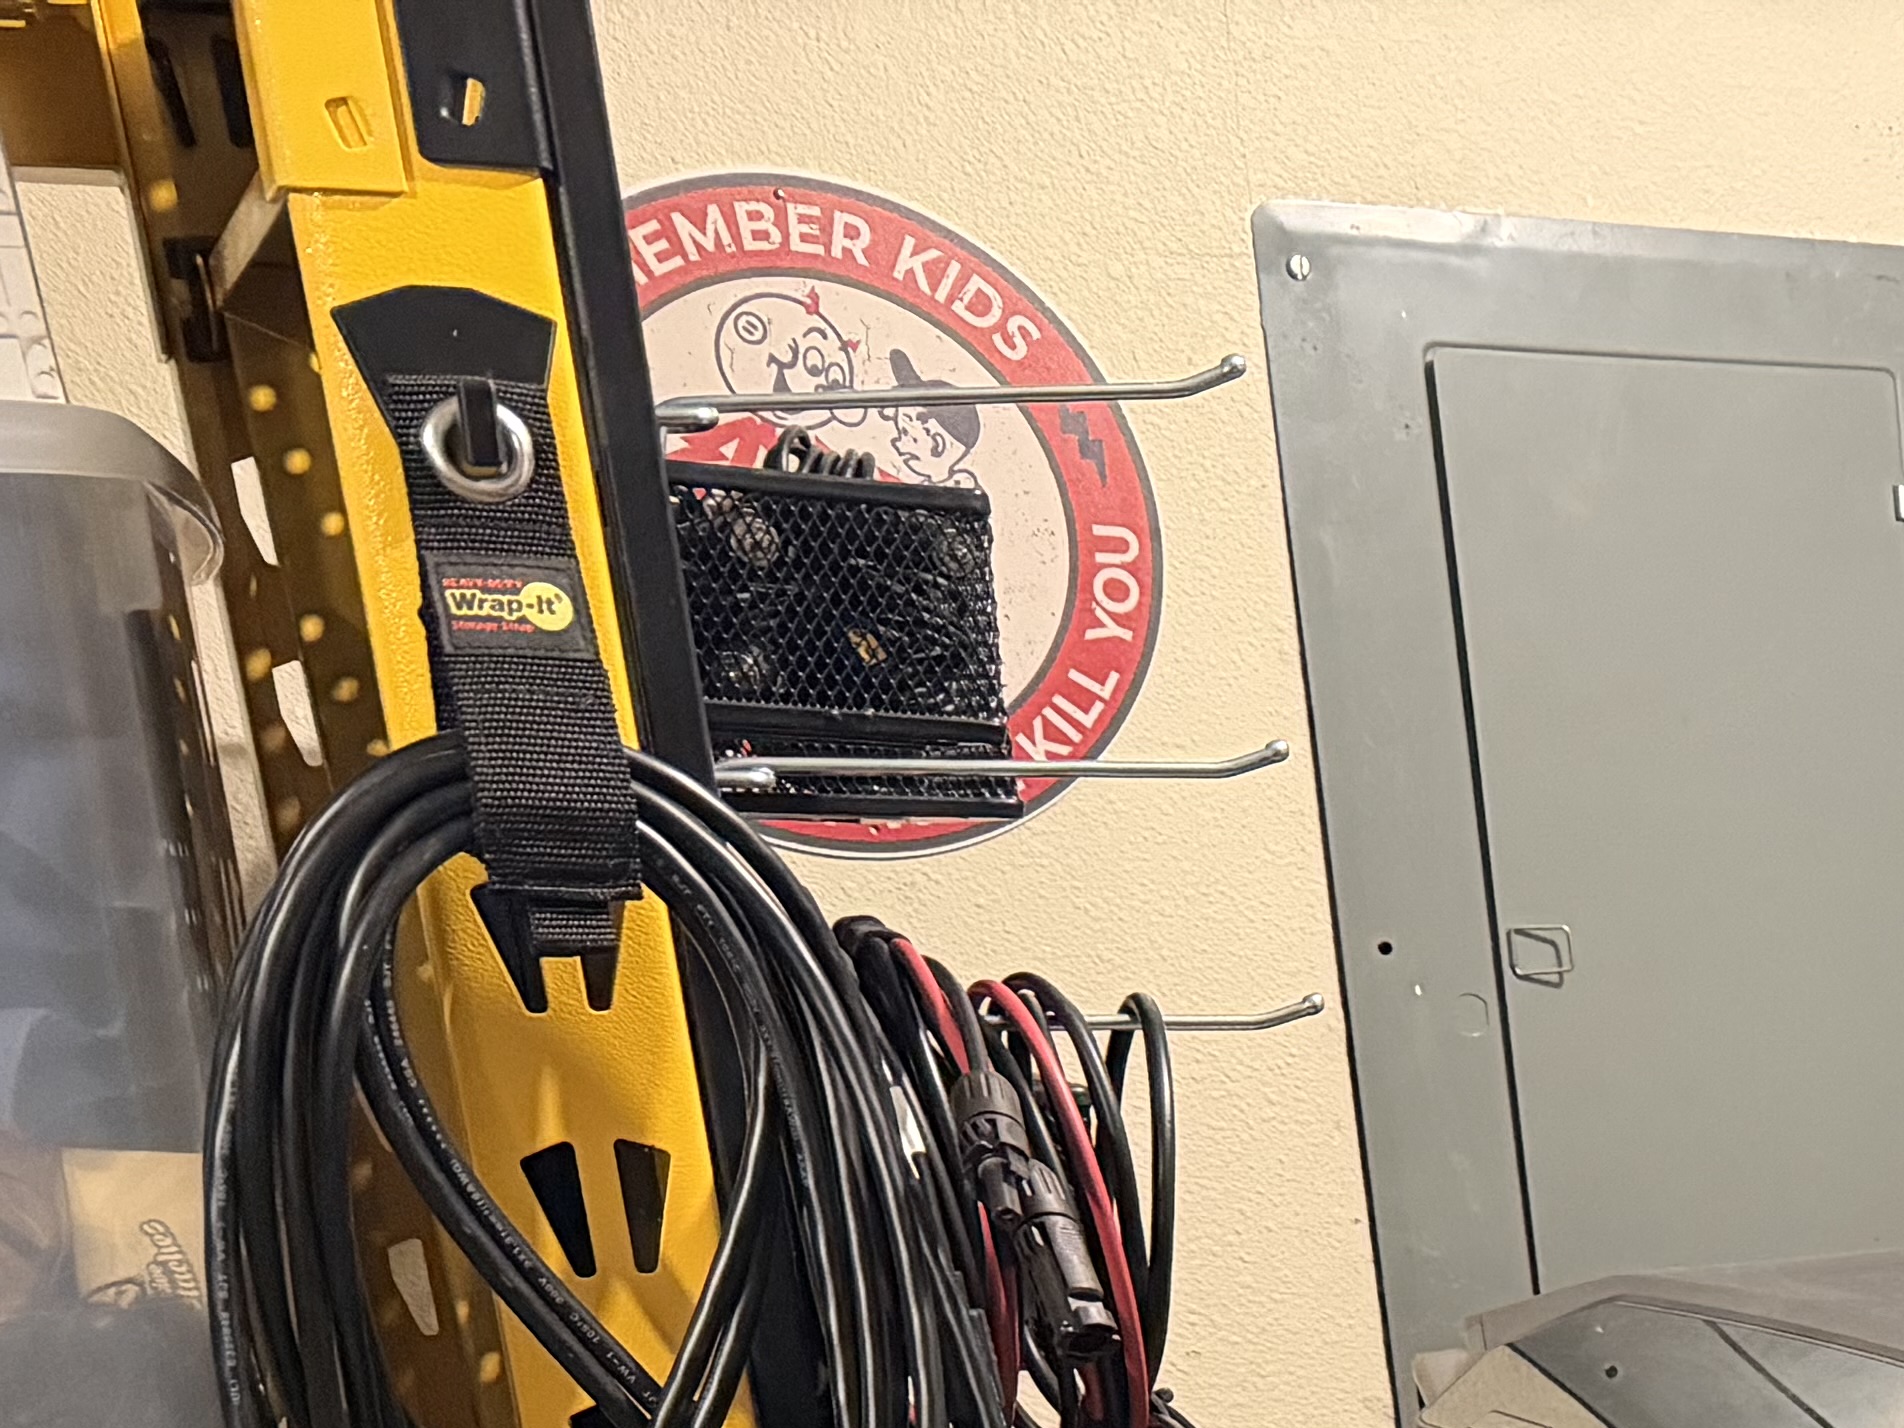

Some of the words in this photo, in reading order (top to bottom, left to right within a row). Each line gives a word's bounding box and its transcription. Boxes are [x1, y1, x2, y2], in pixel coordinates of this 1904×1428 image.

[892, 234, 1042, 362] KIDS
[1015, 668, 1120, 763] KILL
[1084, 524, 1141, 642] YOU
